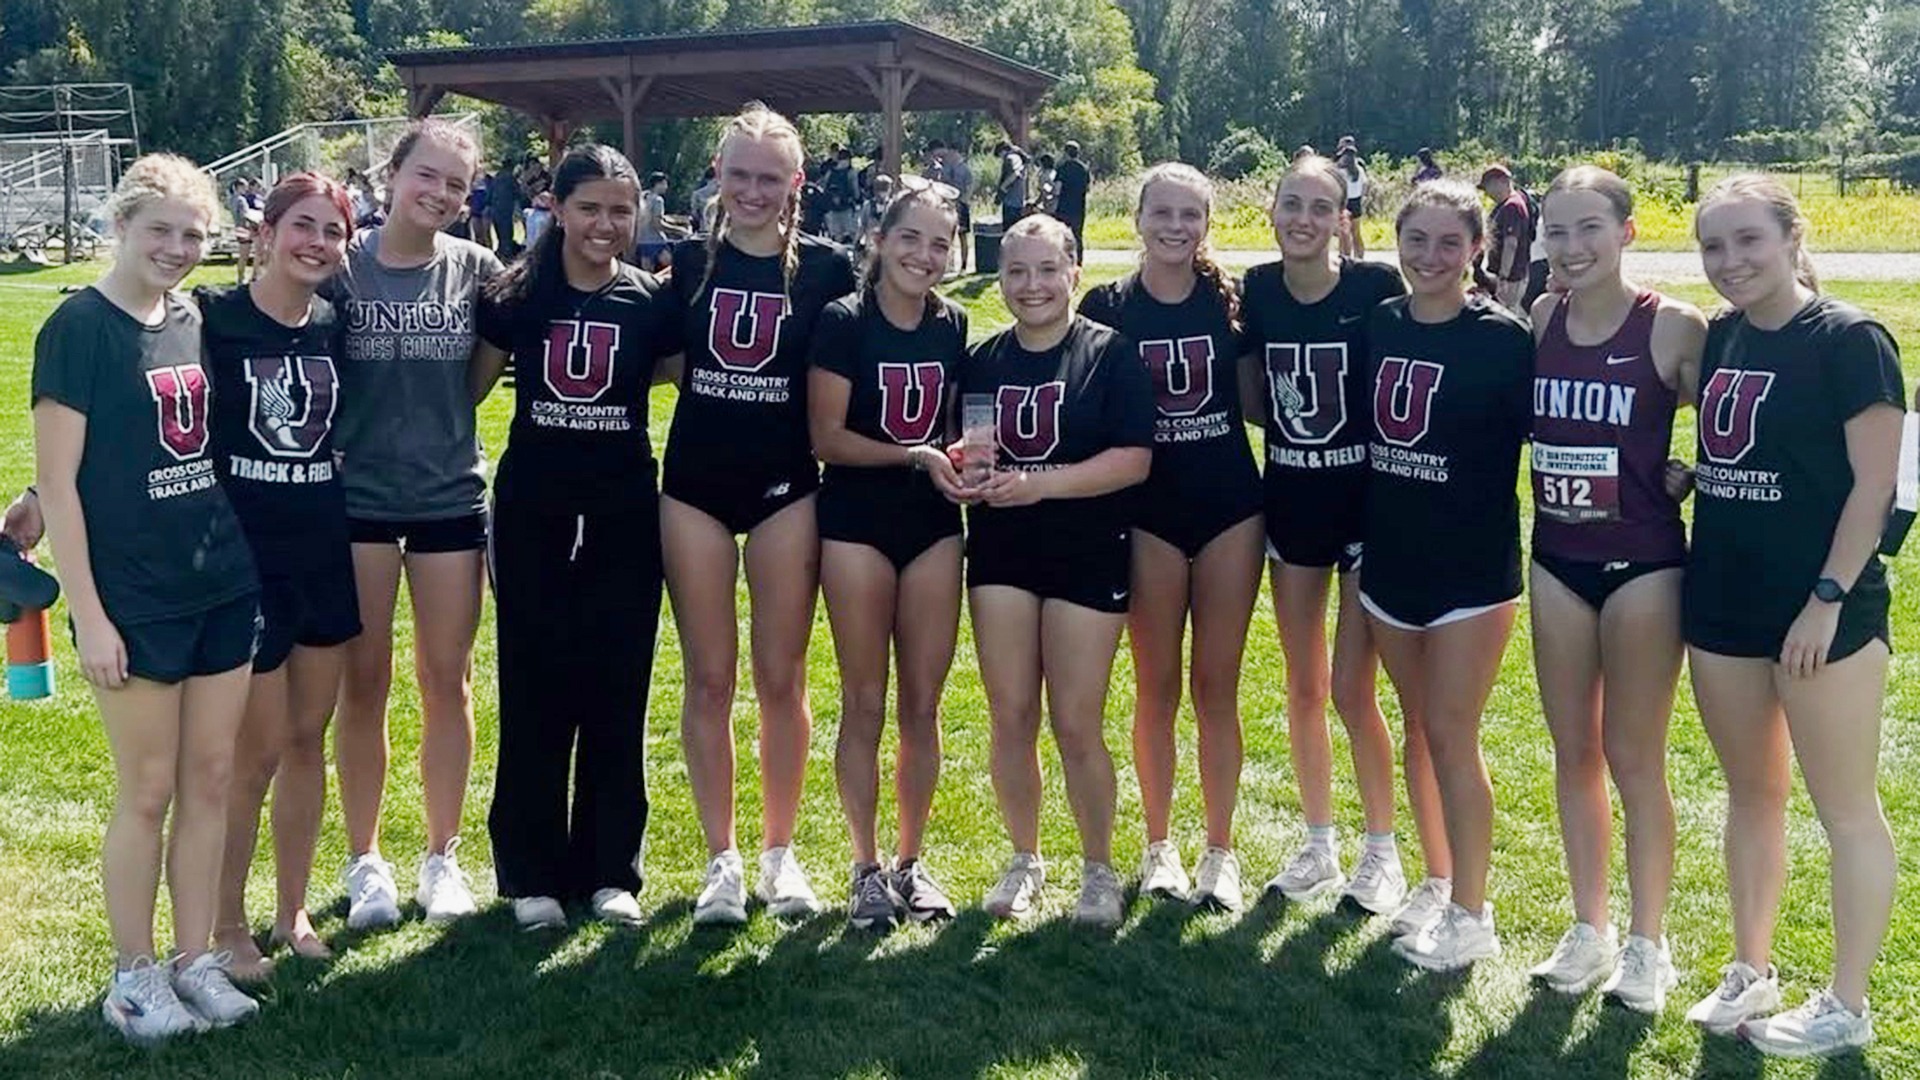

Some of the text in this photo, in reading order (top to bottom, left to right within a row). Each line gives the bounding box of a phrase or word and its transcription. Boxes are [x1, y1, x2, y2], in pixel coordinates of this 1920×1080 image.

[345, 300, 472, 333] UNION
[708, 287, 786, 373] U
[543, 320, 620, 402] U
[1139, 334, 1215, 417] U
[692, 368, 790, 388] CROSS COUNTRY
[692, 382, 790, 403] TRACK AND FIELD
[243, 356, 339, 458] U
[878, 361, 944, 444] U
[1266, 342, 1348, 444] U
[1374, 356, 1444, 447] U
[1533, 377, 1636, 427] UNION
[145, 363, 211, 461] U
[531, 415, 630, 431] TRACK AND FIELD
[568, 405, 628, 417] COUNTRY
[995, 381, 1065, 461] U
[1172, 411, 1228, 428] COUNTRY
[1700, 368, 1776, 464] U
[1173, 430, 1202, 442] AND
[230, 454, 291, 483] TRACK
[291, 464, 306, 483] &
[308, 461, 333, 483] FIEL
[1308, 451, 1322, 468] &
[1324, 445, 1366, 467] FIELD
[1391, 448, 1448, 467] COUNTRY
[148, 465, 187, 483] CROSS
[1390, 463, 1412, 477] AND
[1414, 467, 1449, 482] FIELD
[1712, 466, 1780, 484] COUNTRY
[147, 481, 190, 499] TRACK
[1543, 475, 1593, 507] 512
[1712, 484, 1737, 499] AND
[1739, 487, 1782, 501] FIELD
